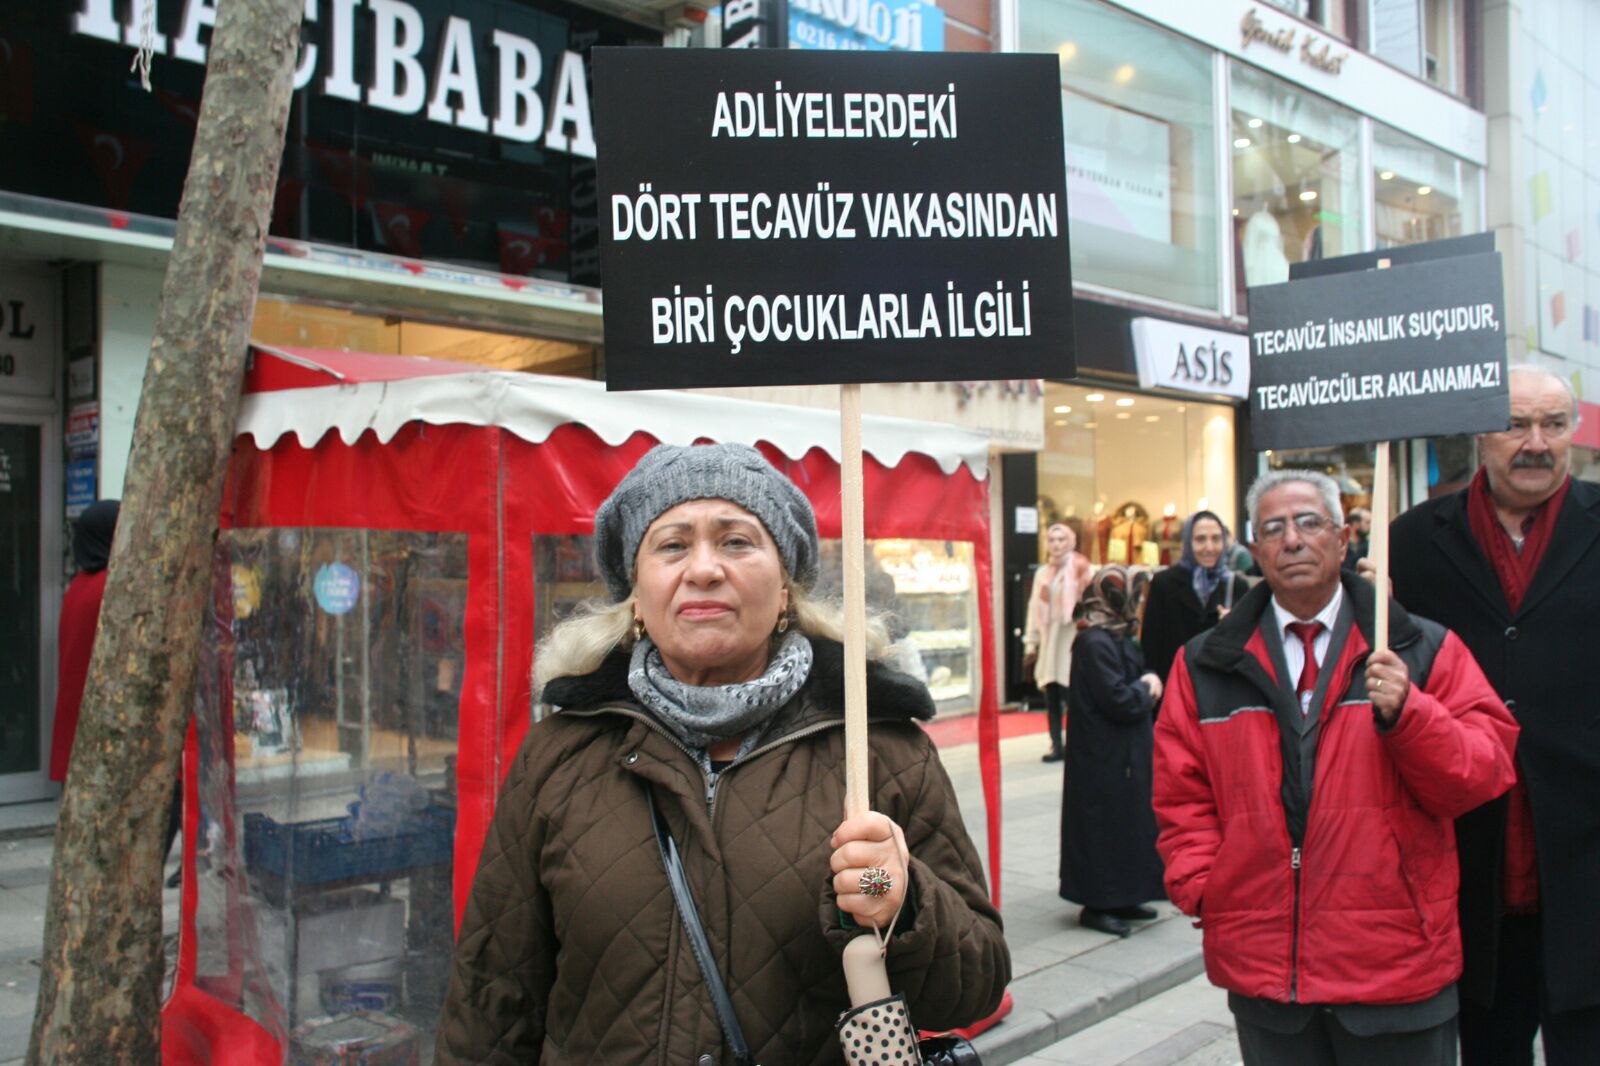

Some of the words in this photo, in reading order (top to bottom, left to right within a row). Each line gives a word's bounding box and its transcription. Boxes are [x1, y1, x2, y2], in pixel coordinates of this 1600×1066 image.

[73, 0, 597, 158] IBABA
[712, 81, 958, 138] ADLİYELERDEKİ
[612, 183, 701, 241] DÖRT
[709, 182, 857, 239] TECAVÜZ
[861, 192, 1059, 238] VAKASINDAN
[652, 285, 715, 344] BİRİ
[724, 293, 942, 354] ÇOCUKLARLA
[948, 280, 1032, 337] İLGİLİ
[1254, 321, 1326, 355] TECAVÜZ
[1329, 315, 1405, 347] İNSANLIK
[1408, 303, 1500, 341] SUÇUDUR,
[1171, 340, 1233, 386] ASİS
[1258, 373, 1385, 409] TECAVÜZCÜLER
[1387, 362, 1501, 397] AKLANAMAZ!
